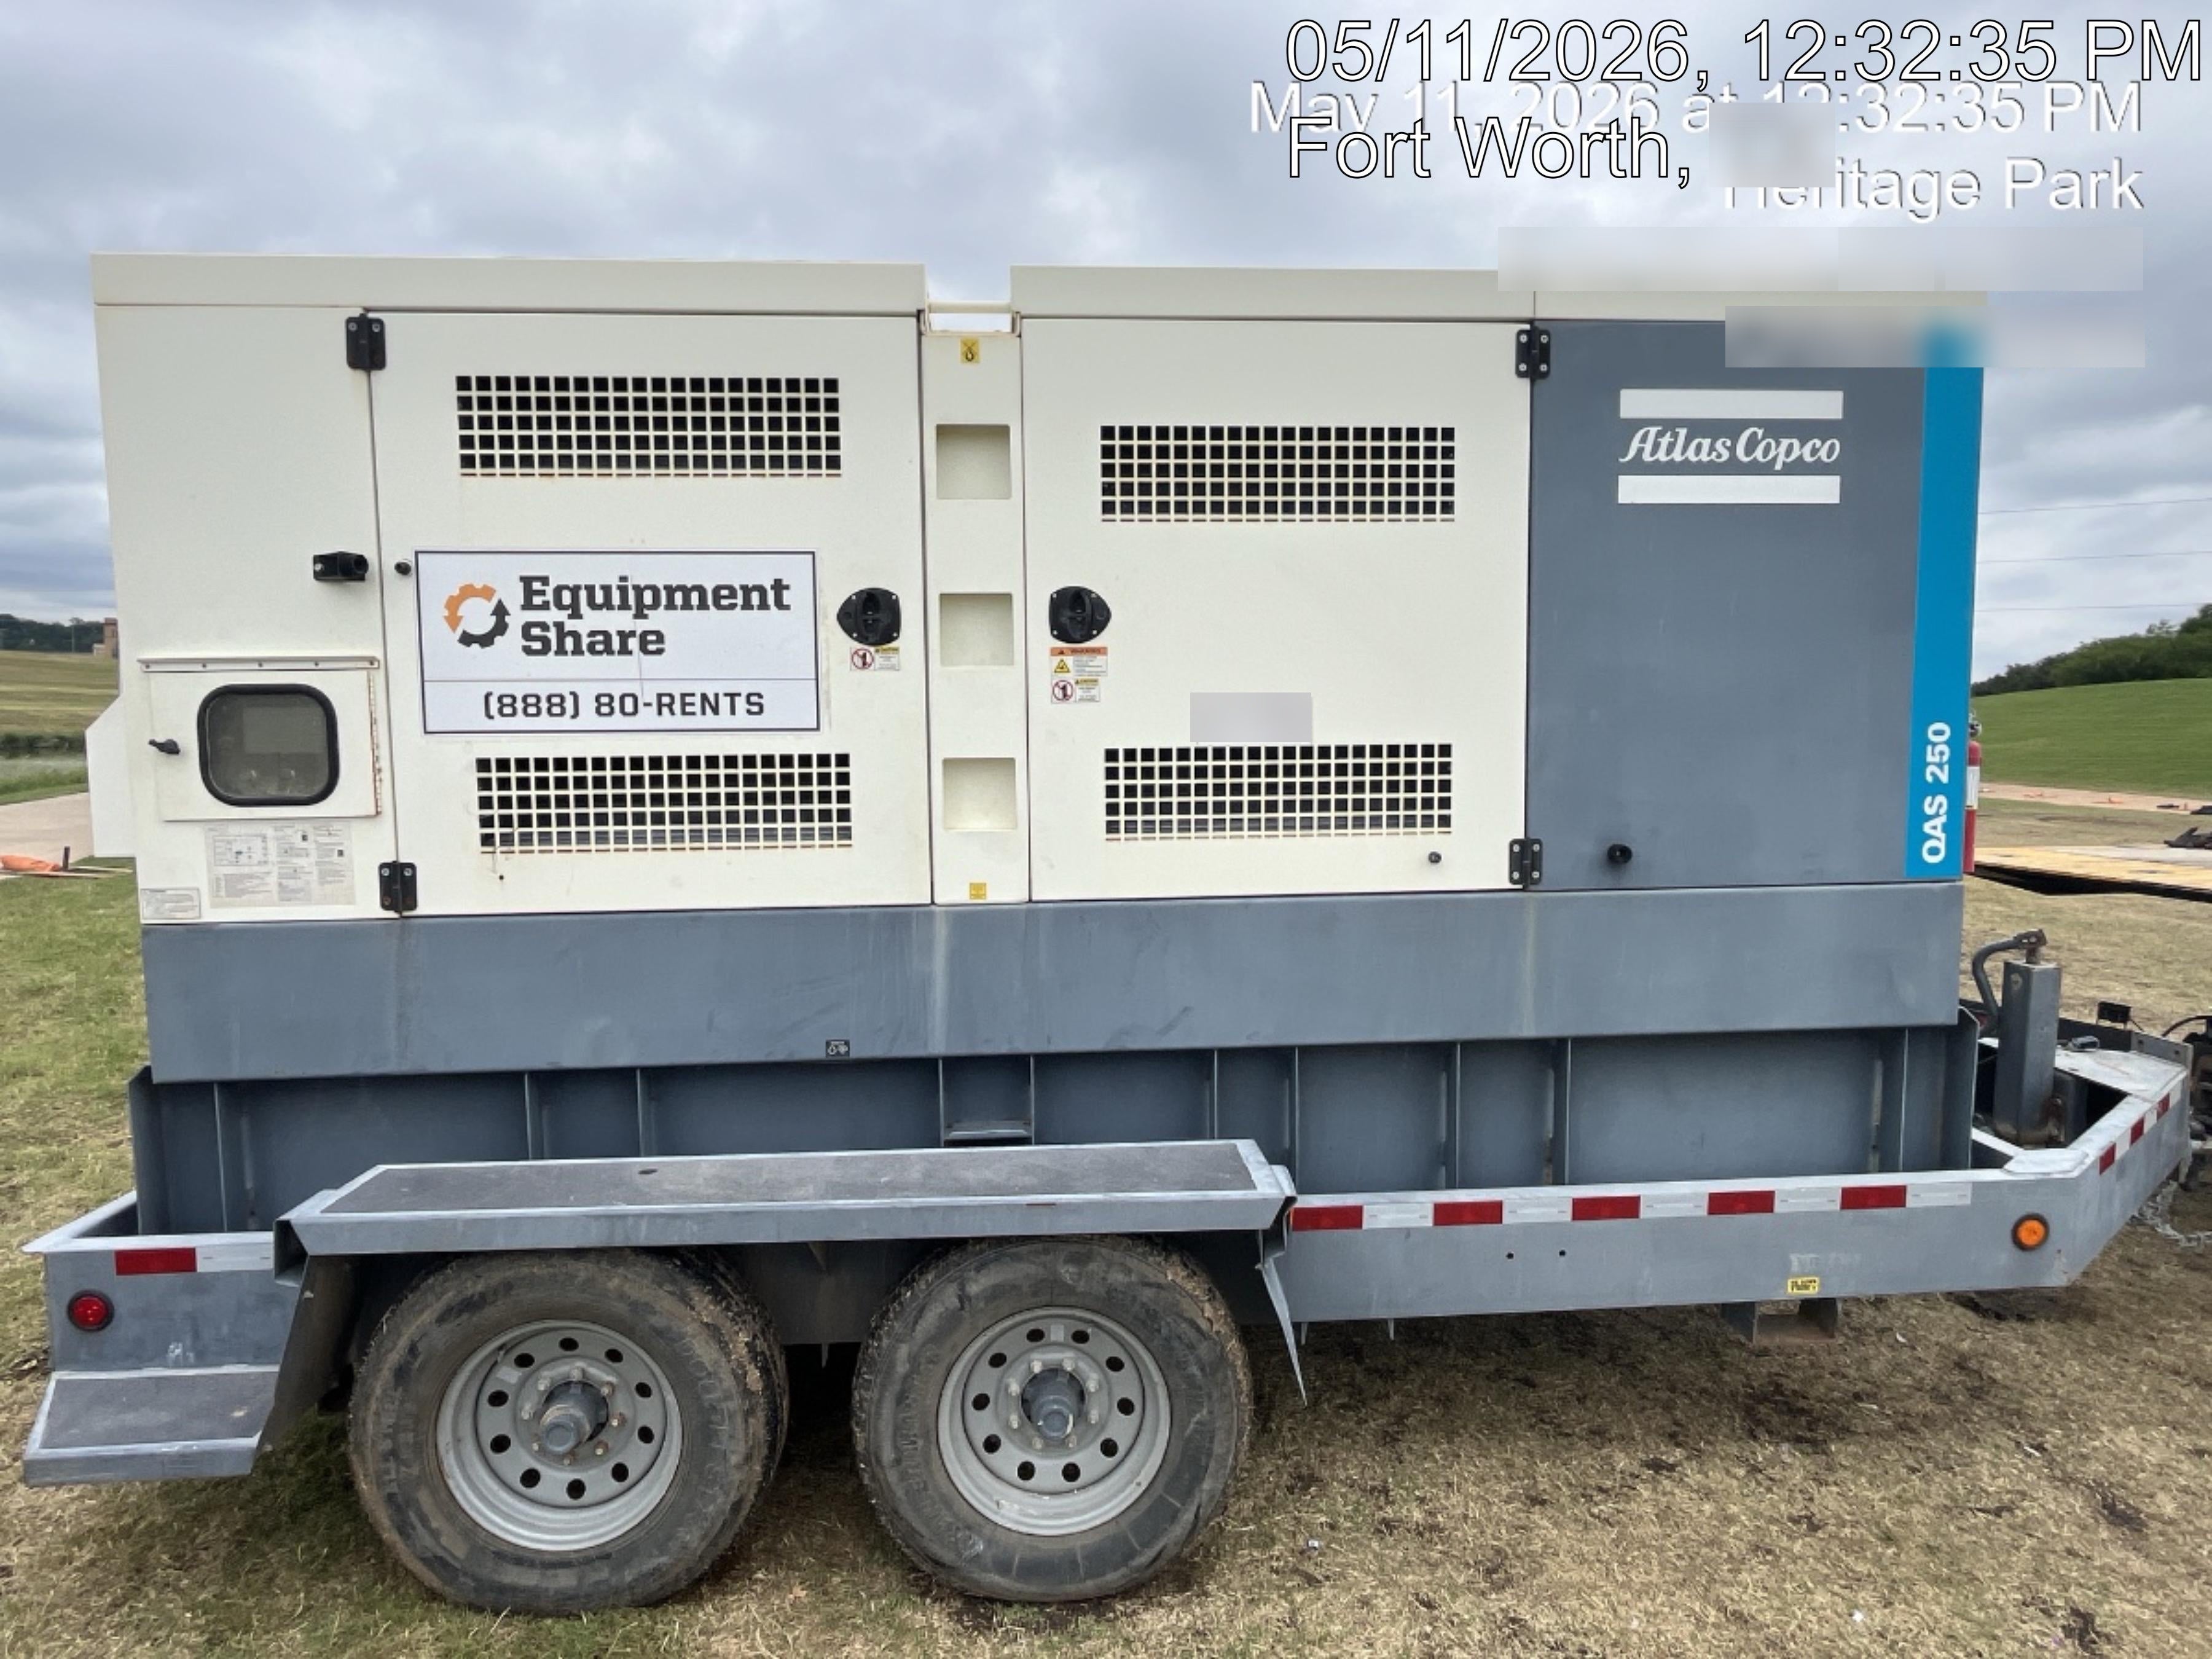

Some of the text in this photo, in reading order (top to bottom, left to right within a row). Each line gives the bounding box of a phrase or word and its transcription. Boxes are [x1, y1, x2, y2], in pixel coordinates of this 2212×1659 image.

[1618, 425, 1841, 471] Atlas Copco
[519, 575, 791, 620] Equipment
[520, 621, 665, 656] Share
[483, 691, 765, 720] (888) 80-RENTS
[1921, 721, 1951, 864] QAS 250
